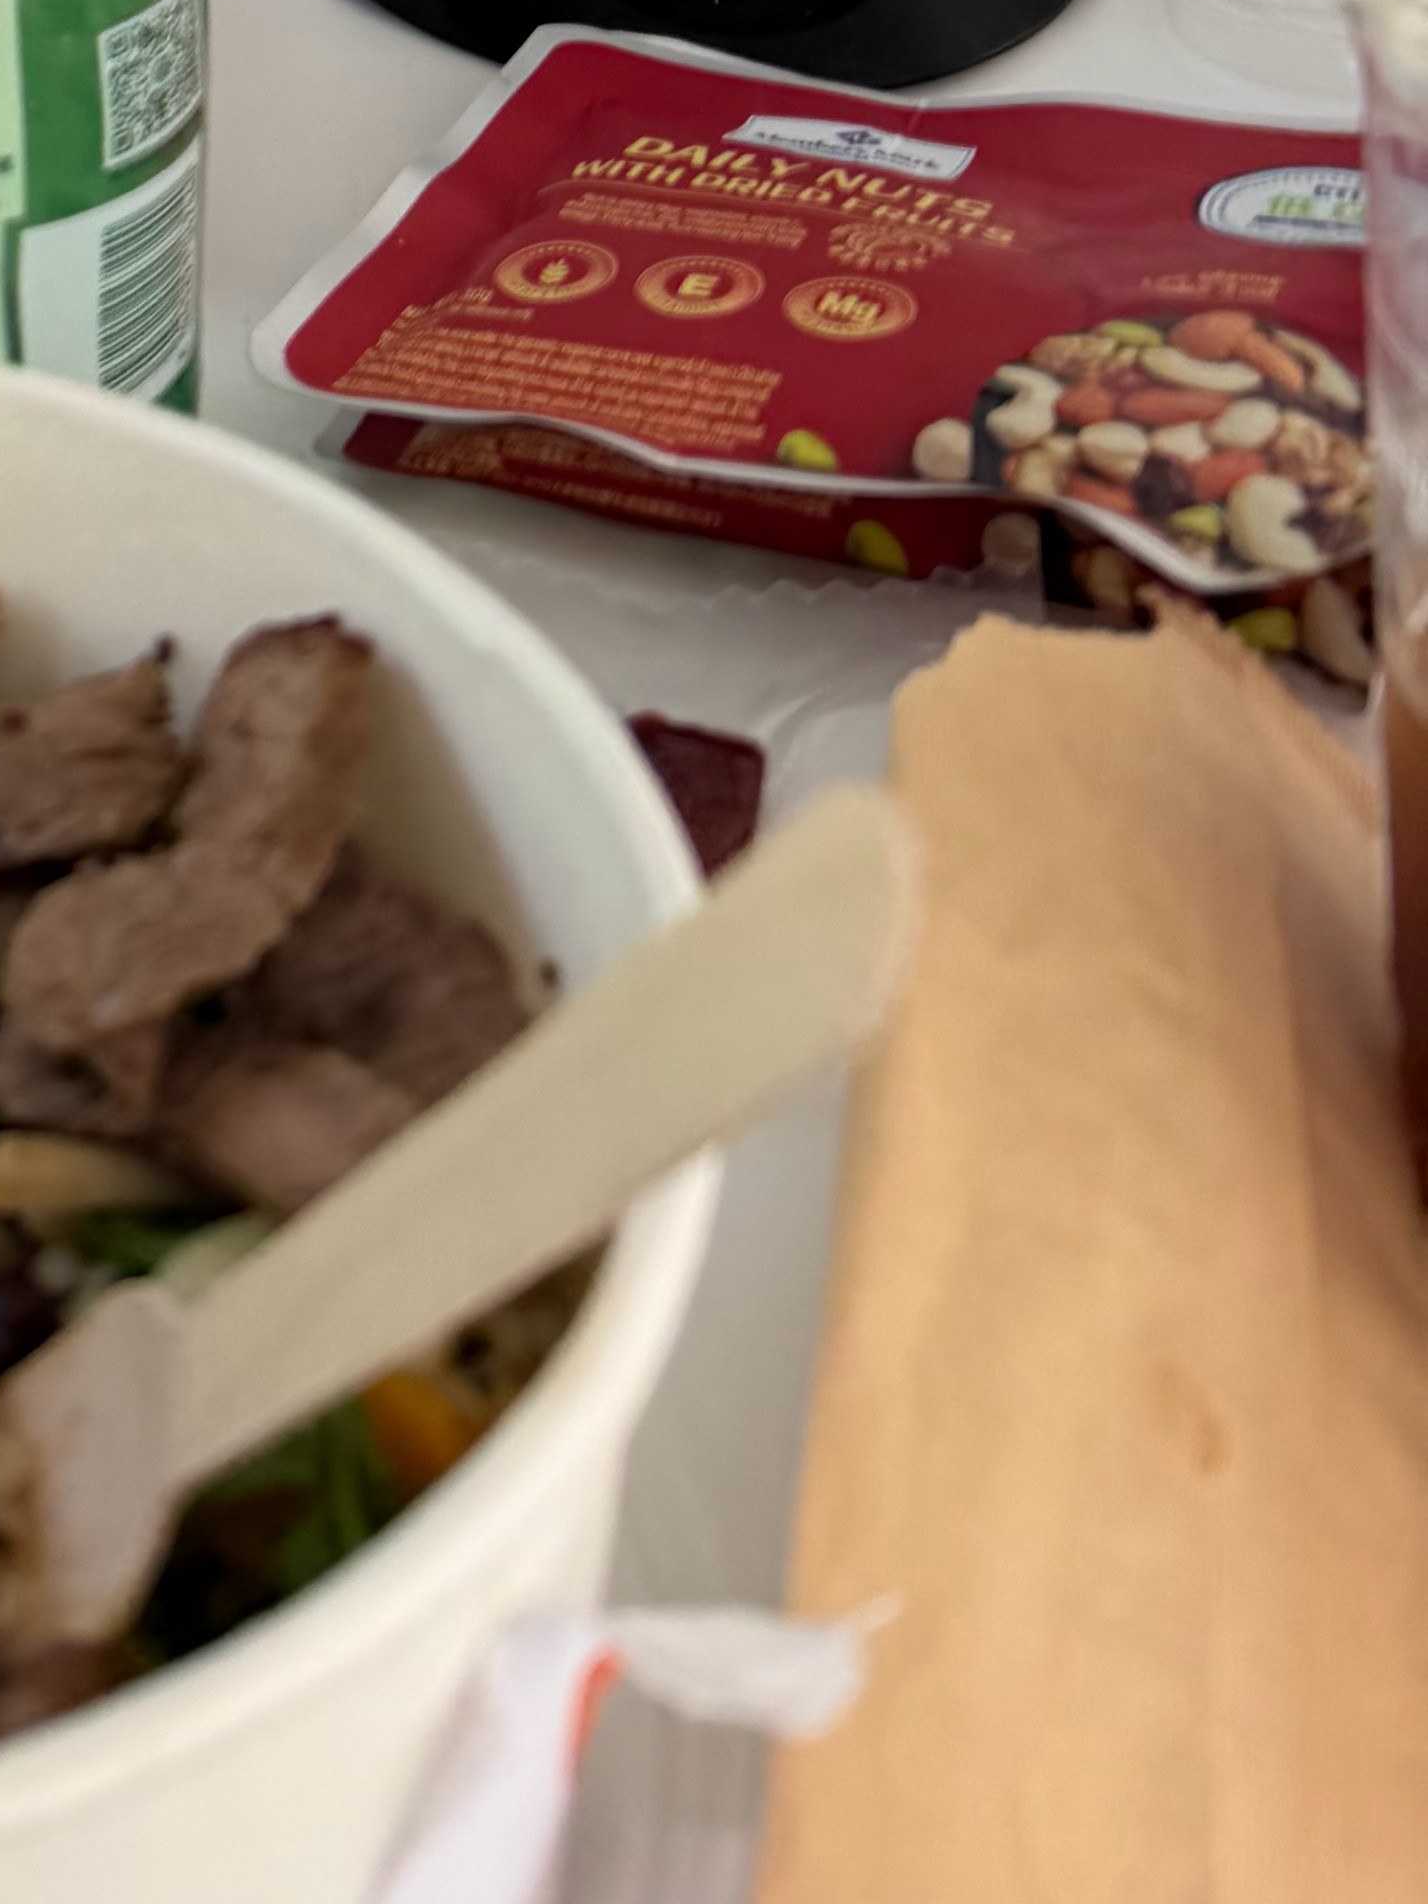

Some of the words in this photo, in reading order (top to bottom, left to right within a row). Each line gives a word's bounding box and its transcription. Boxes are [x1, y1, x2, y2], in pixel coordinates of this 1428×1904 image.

[571, 159, 685, 186] WITH
[690, 171, 834, 204] DRIED
[840, 196, 1016, 247] FRUITS
[623, 136, 811, 177] DAILY
[815, 168, 993, 219] NUTS
[677, 273, 720, 297] E
[816, 290, 879, 325] Mg
